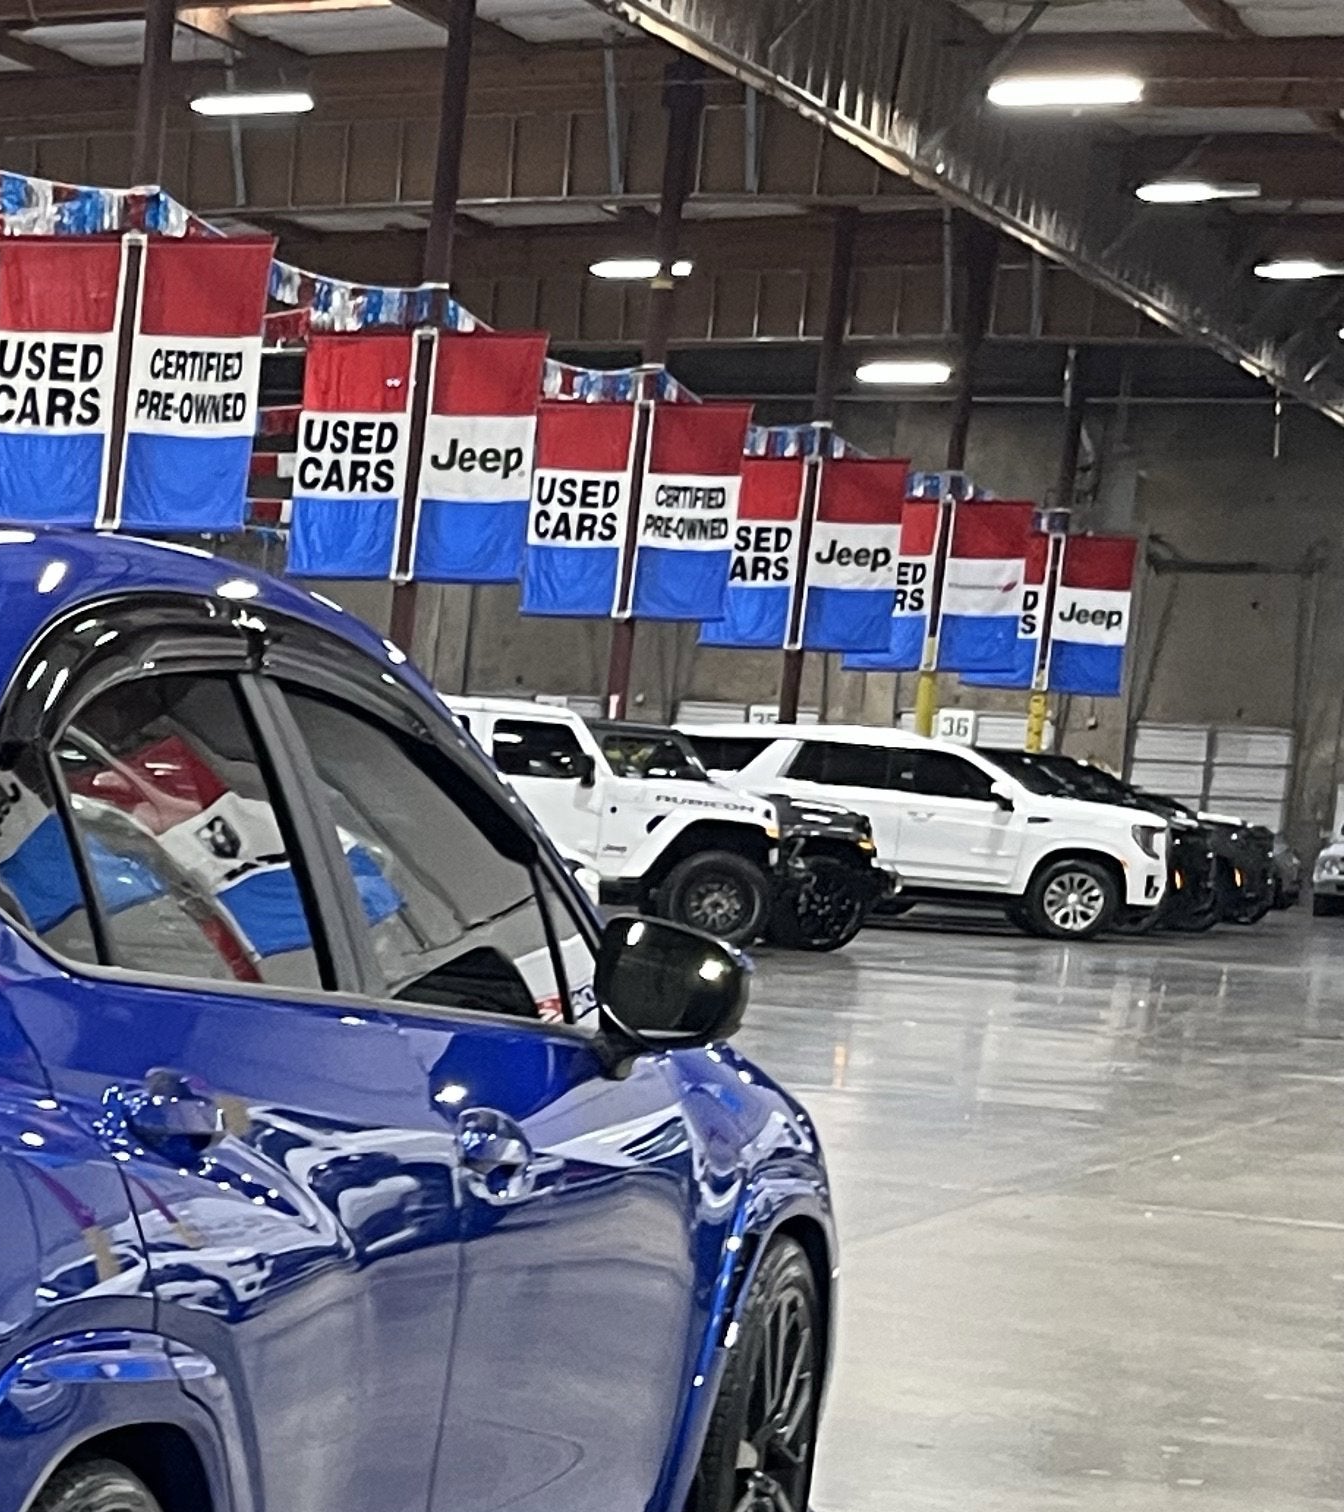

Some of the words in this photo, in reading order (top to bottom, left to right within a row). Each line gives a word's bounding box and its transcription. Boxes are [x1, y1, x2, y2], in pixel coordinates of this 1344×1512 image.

[150, 348, 243, 383] CERTIFIED
[133, 388, 247, 424] PRE-OWNED
[303, 419, 399, 455] USED
[298, 456, 395, 493] CARS
[430, 438, 524, 480] Jeep
[537, 476, 620, 509] USED
[655, 484, 726, 510] CERTIFIED
[534, 509, 618, 541] CARS
[642, 513, 729, 541] PRE-OWNED
[734, 525, 793, 553] SED
[729, 555, 789, 581] ARS
[815, 539, 892, 573] Jeep
[896, 562, 927, 585] ED
[895, 588, 924, 611] RS
[1058, 601, 1123, 632] Jeep
[941, 716, 969, 738] 36
